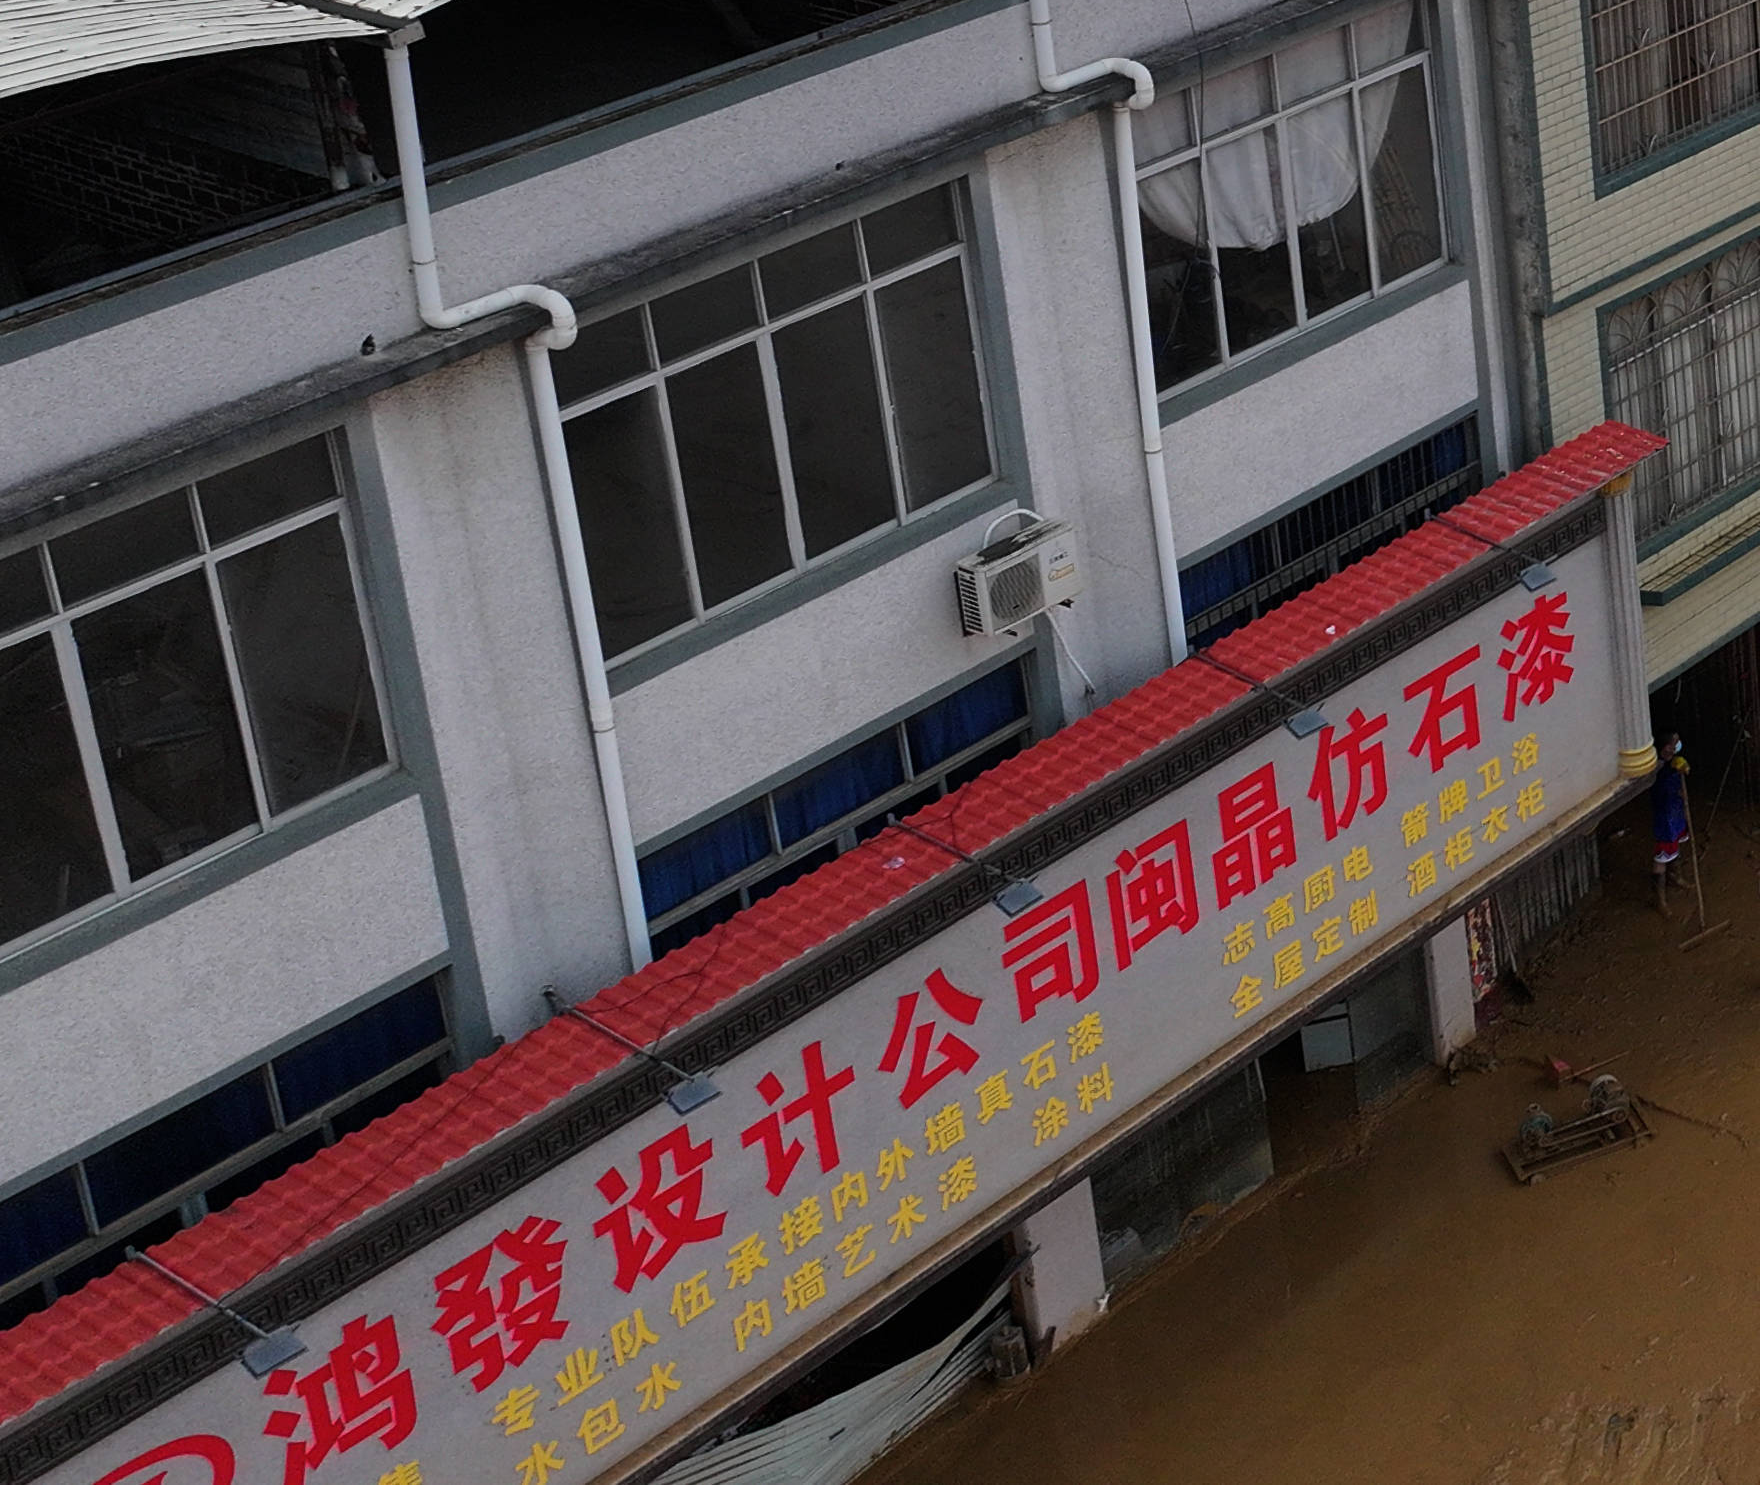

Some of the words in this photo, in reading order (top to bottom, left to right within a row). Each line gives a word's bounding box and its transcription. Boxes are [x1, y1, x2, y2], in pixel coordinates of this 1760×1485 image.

[1220, 845, 1375, 967] 志高厨电
[1400, 732, 1542, 849] 箭牌卫浴
[1229, 888, 1380, 1019] 全屋定制
[1405, 778, 1547, 899] 酒柜衣柜
[490, 1011, 1105, 1436] 专业队伍承接内外墙真石漆
[515, 1361, 682, 1485] 水包水
[731, 1158, 980, 1352] 内墙艺术漆
[1031, 1063, 1116, 1147] 涂料
